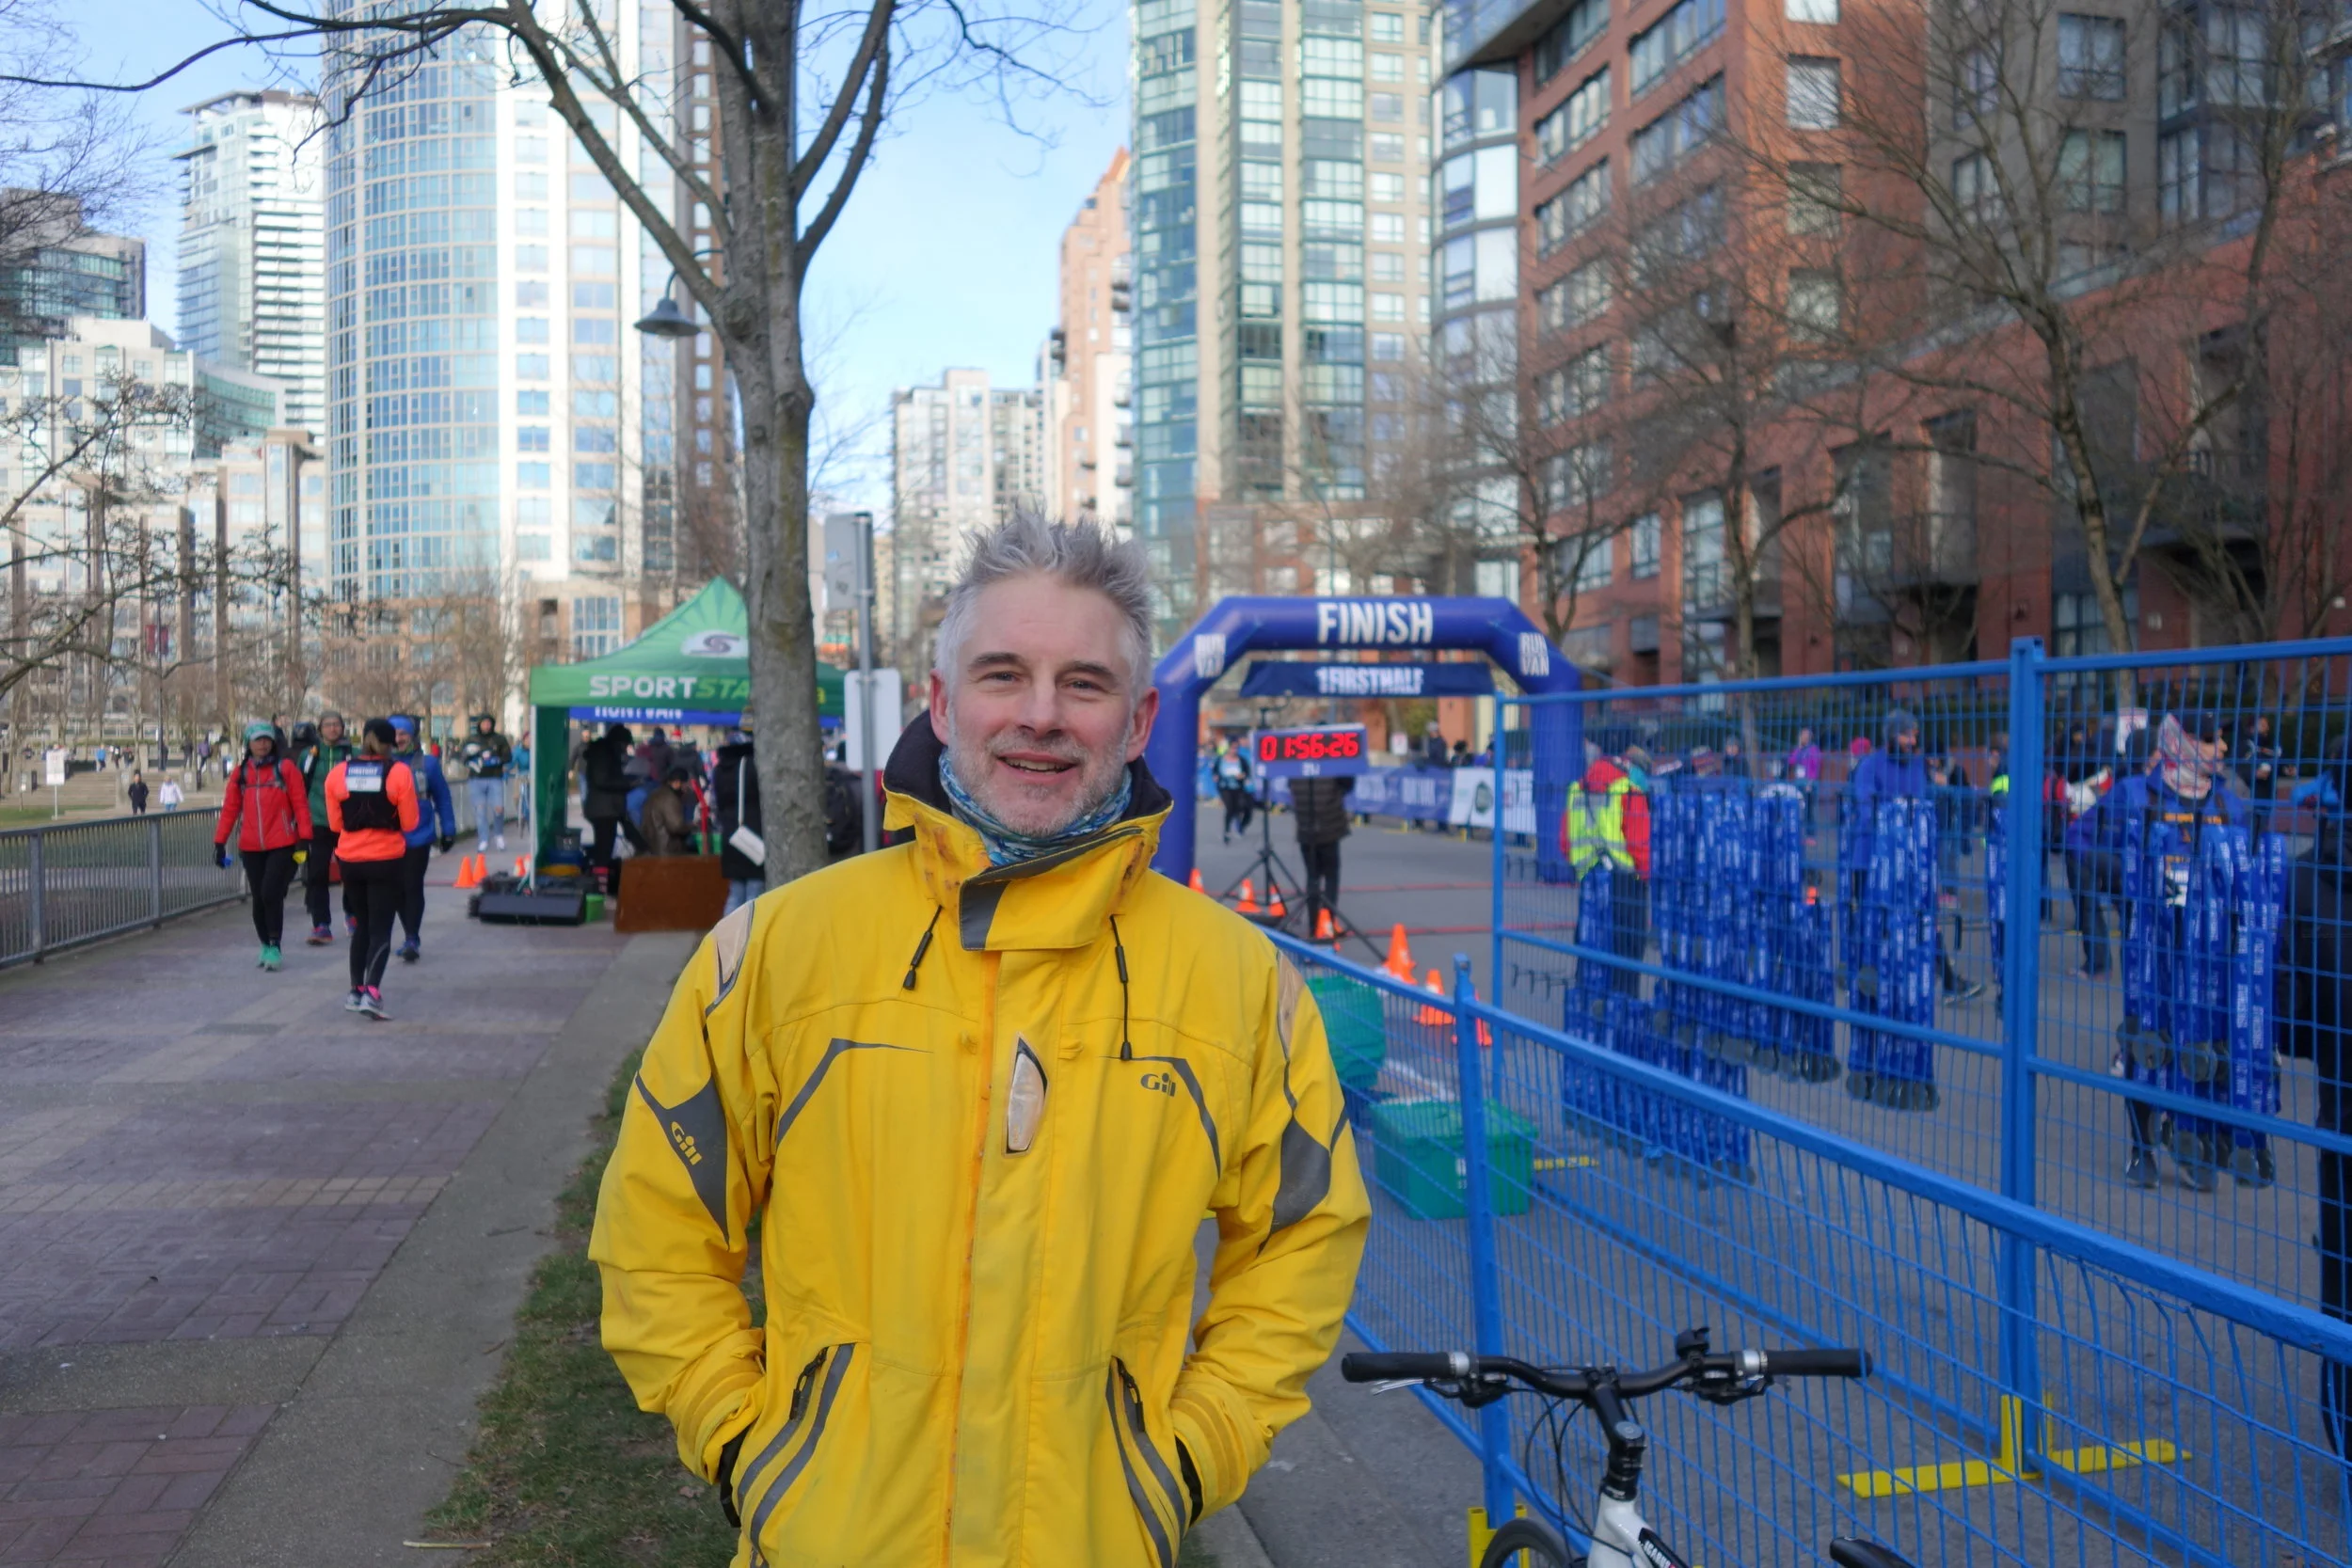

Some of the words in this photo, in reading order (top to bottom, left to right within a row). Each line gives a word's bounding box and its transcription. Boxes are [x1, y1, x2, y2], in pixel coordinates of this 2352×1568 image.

[1318, 602, 1433, 644] FINISH
[590, 675, 750, 699] SPORTSTA
[1140, 1072, 1176, 1098] Gill
[671, 1120, 703, 1165] Gill
